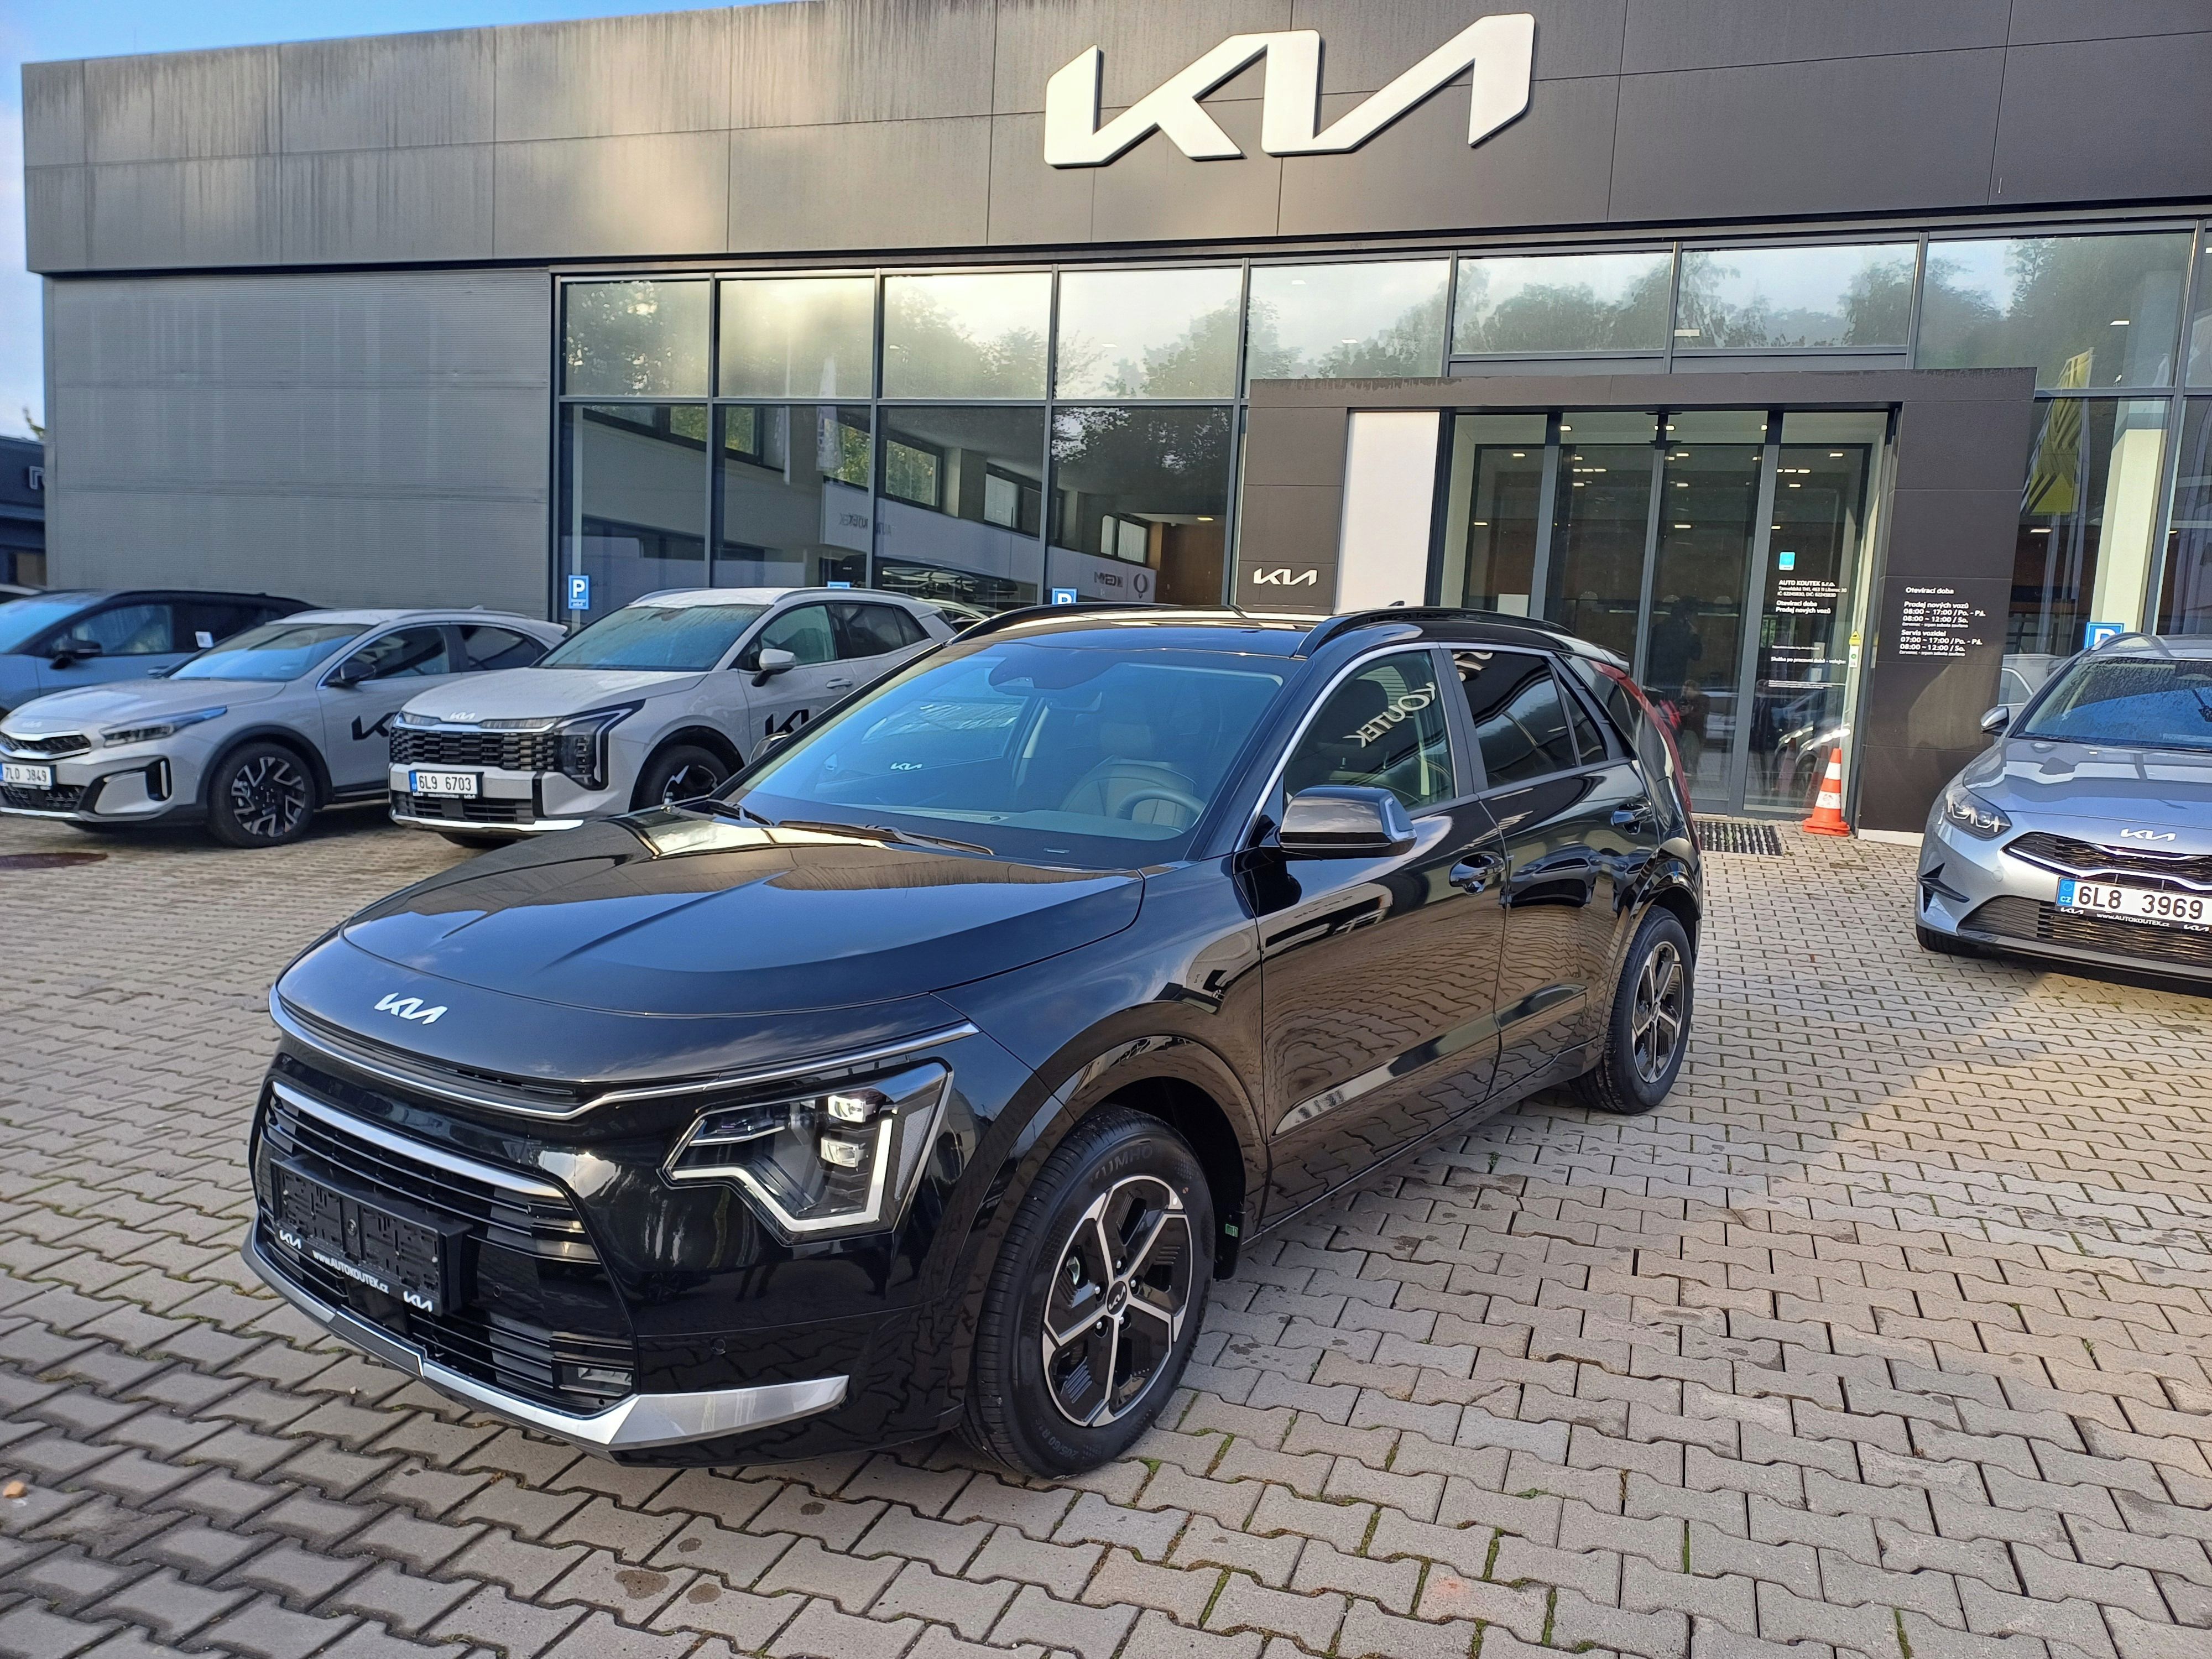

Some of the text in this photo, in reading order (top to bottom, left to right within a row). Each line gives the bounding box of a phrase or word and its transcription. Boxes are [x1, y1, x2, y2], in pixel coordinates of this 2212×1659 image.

[1044, 12, 1536, 168] KIA
[1253, 567, 1318, 586] KIA
[572, 579, 585, 598] P
[419, 775, 437, 790] 6L9
[445, 776, 472, 791] 6703
[2120, 828, 2177, 842] KIA
[2079, 886, 2204, 920] 6L8 3969
[2096, 913, 2171, 928] www.AUTOKOUTEK.cz
[2183, 924, 2209, 932] KIA
[374, 992, 448, 1025] KIA
[279, 1229, 302, 1250] KIA
[312, 1249, 390, 1295] www.AUTOKOUTEK.cz
[403, 1290, 433, 1313] KIA
